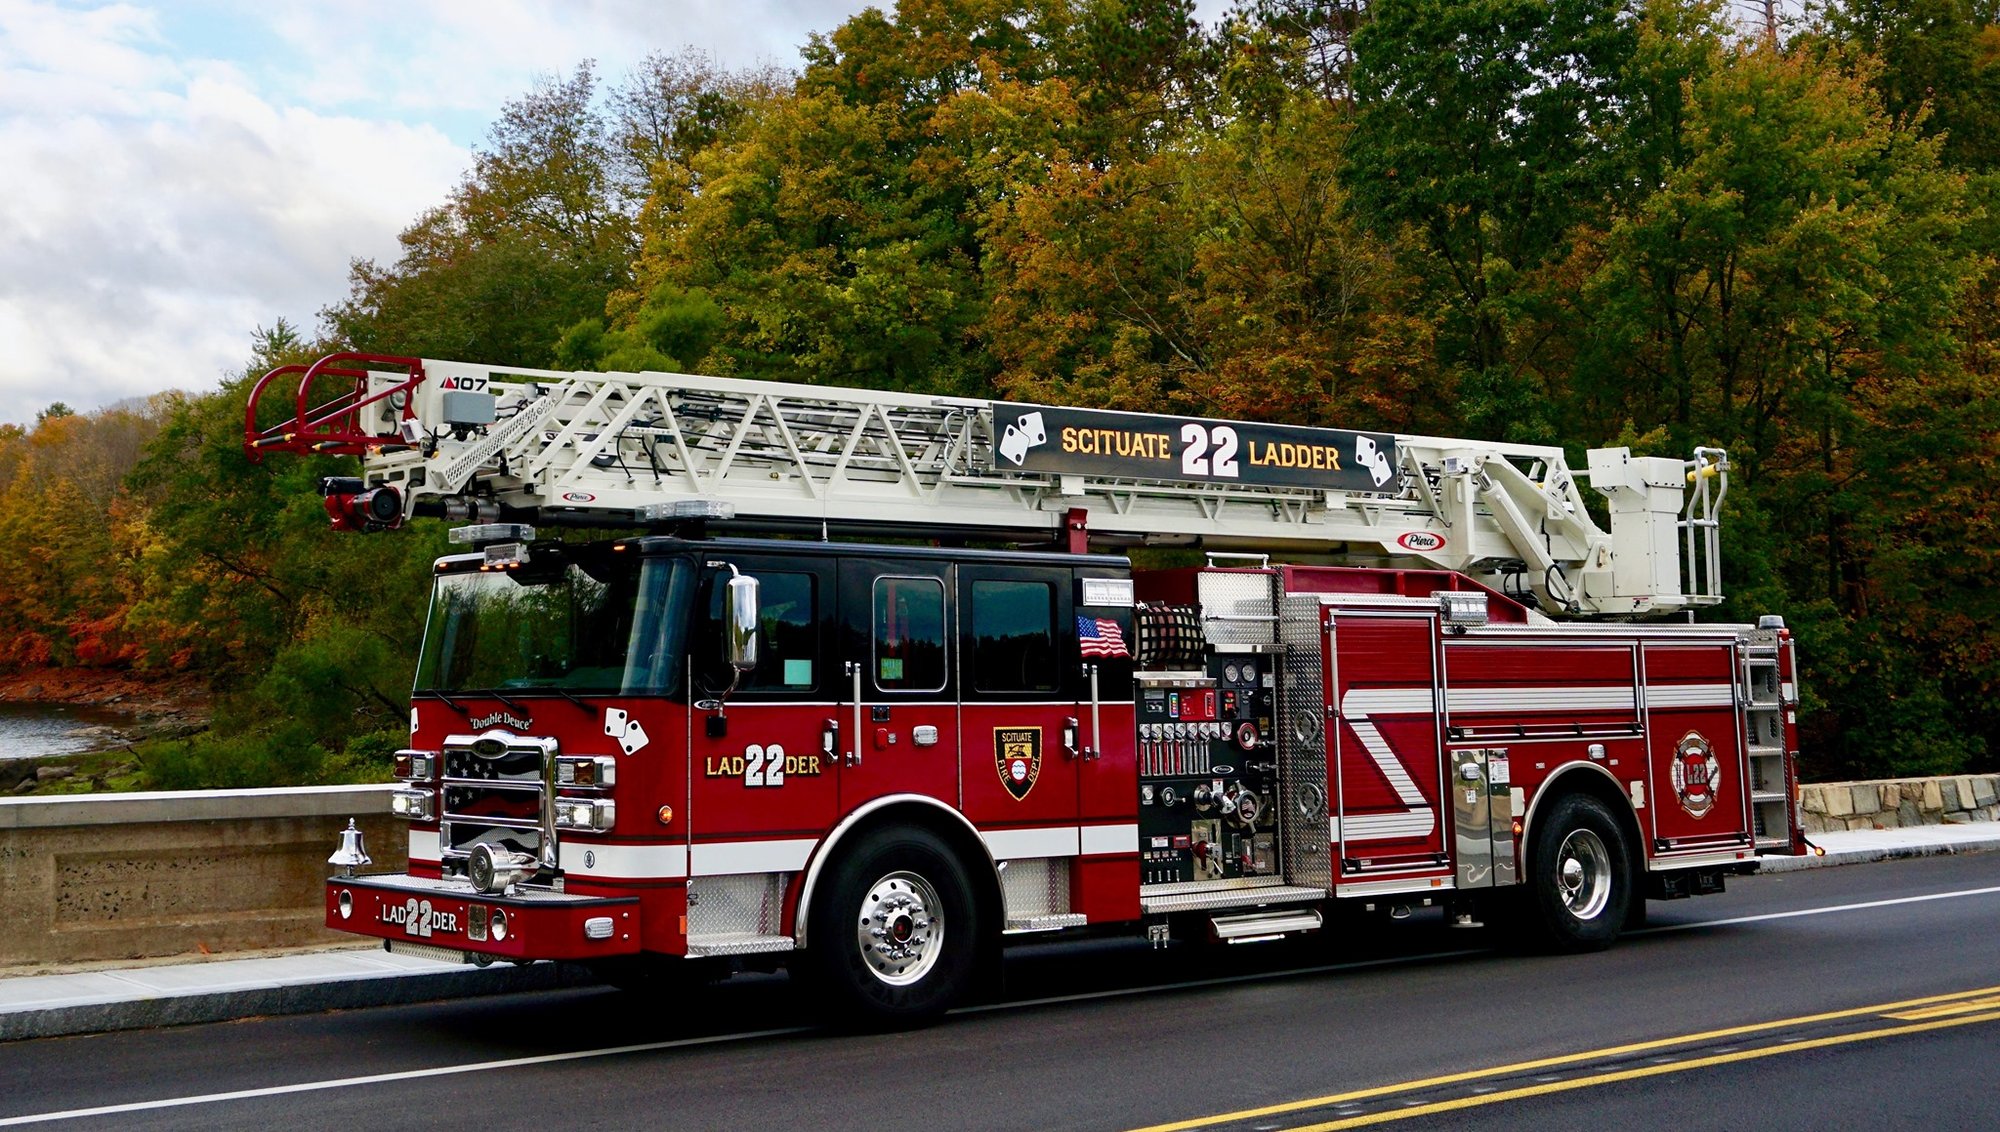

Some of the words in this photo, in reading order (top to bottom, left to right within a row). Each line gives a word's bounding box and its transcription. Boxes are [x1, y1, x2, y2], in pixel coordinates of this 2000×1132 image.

[1062, 426, 1171, 460] SCITUATE
[1180, 423, 1239, 478] 22
[1249, 440, 1342, 471] LADDER
[1408, 534, 1435, 547] Pierce
[1001, 732, 1032, 743] SCITUATE
[997, 758, 1012, 784] FIRE
